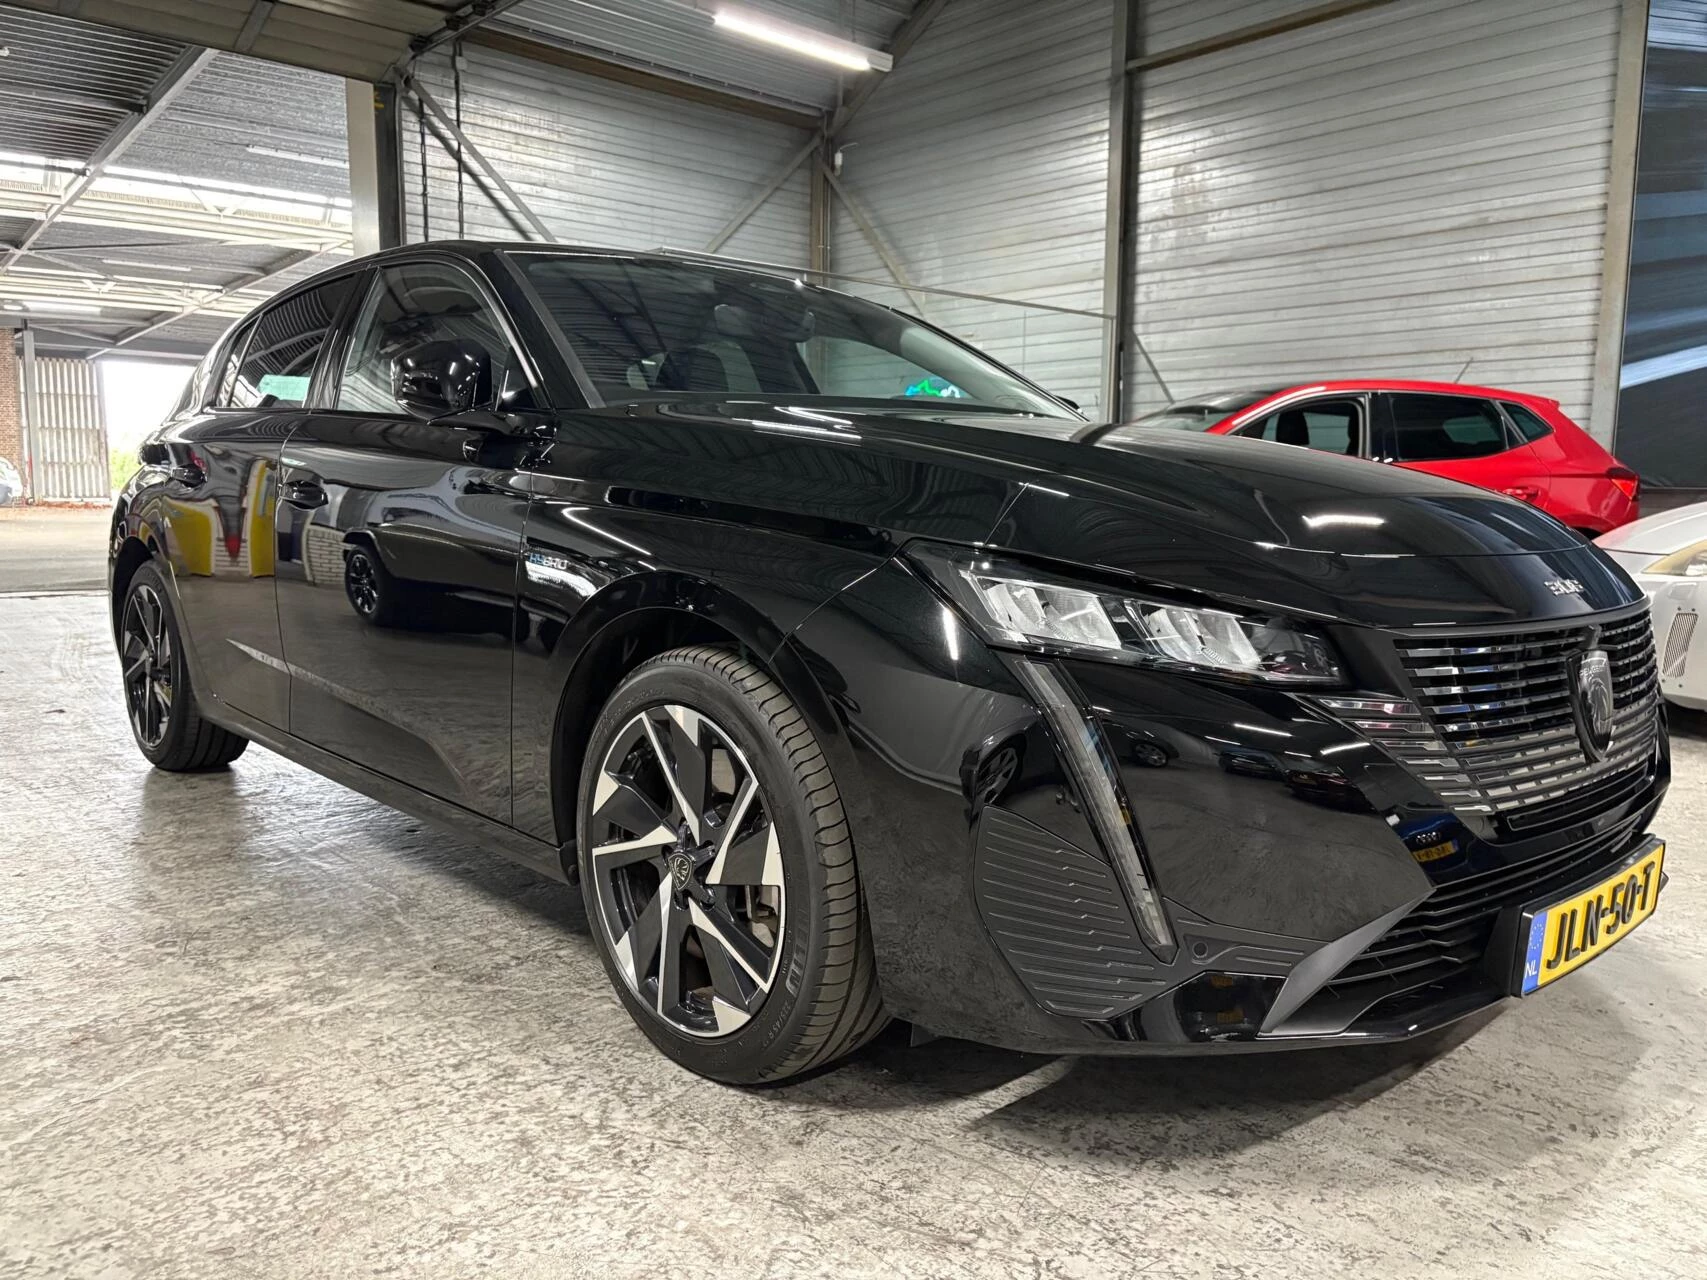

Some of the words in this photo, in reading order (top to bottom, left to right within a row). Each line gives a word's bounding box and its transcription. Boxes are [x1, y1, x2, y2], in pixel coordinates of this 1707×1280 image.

[1544, 578, 1584, 596] 308
[1546, 861, 1656, 970] JLN-50-T
[1524, 959, 1538, 978] NL
